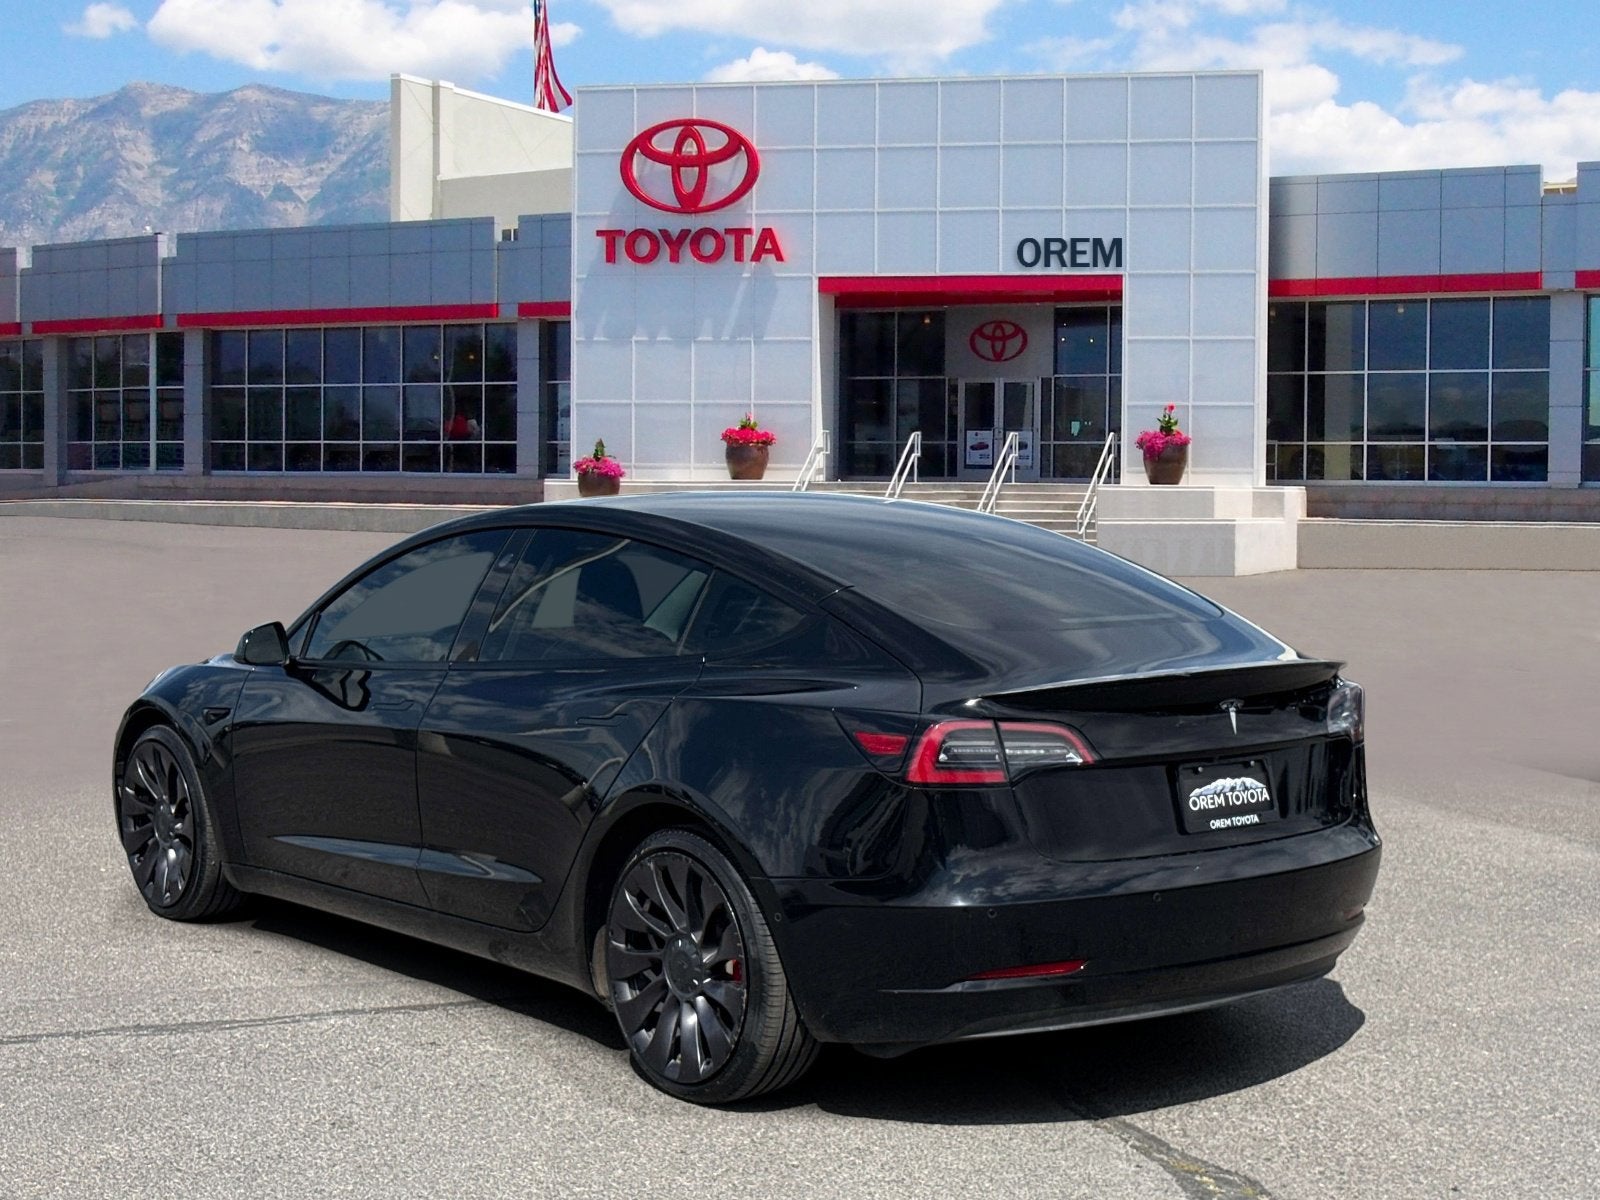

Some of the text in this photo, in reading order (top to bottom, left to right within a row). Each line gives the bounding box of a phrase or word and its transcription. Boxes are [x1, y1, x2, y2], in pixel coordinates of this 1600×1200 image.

[596, 227, 785, 265] TOYOTA
[1016, 237, 1123, 268] OREM
[1188, 788, 1270, 811] OREM TOYOTA
[1210, 814, 1260, 830] OREM TOYOTA
